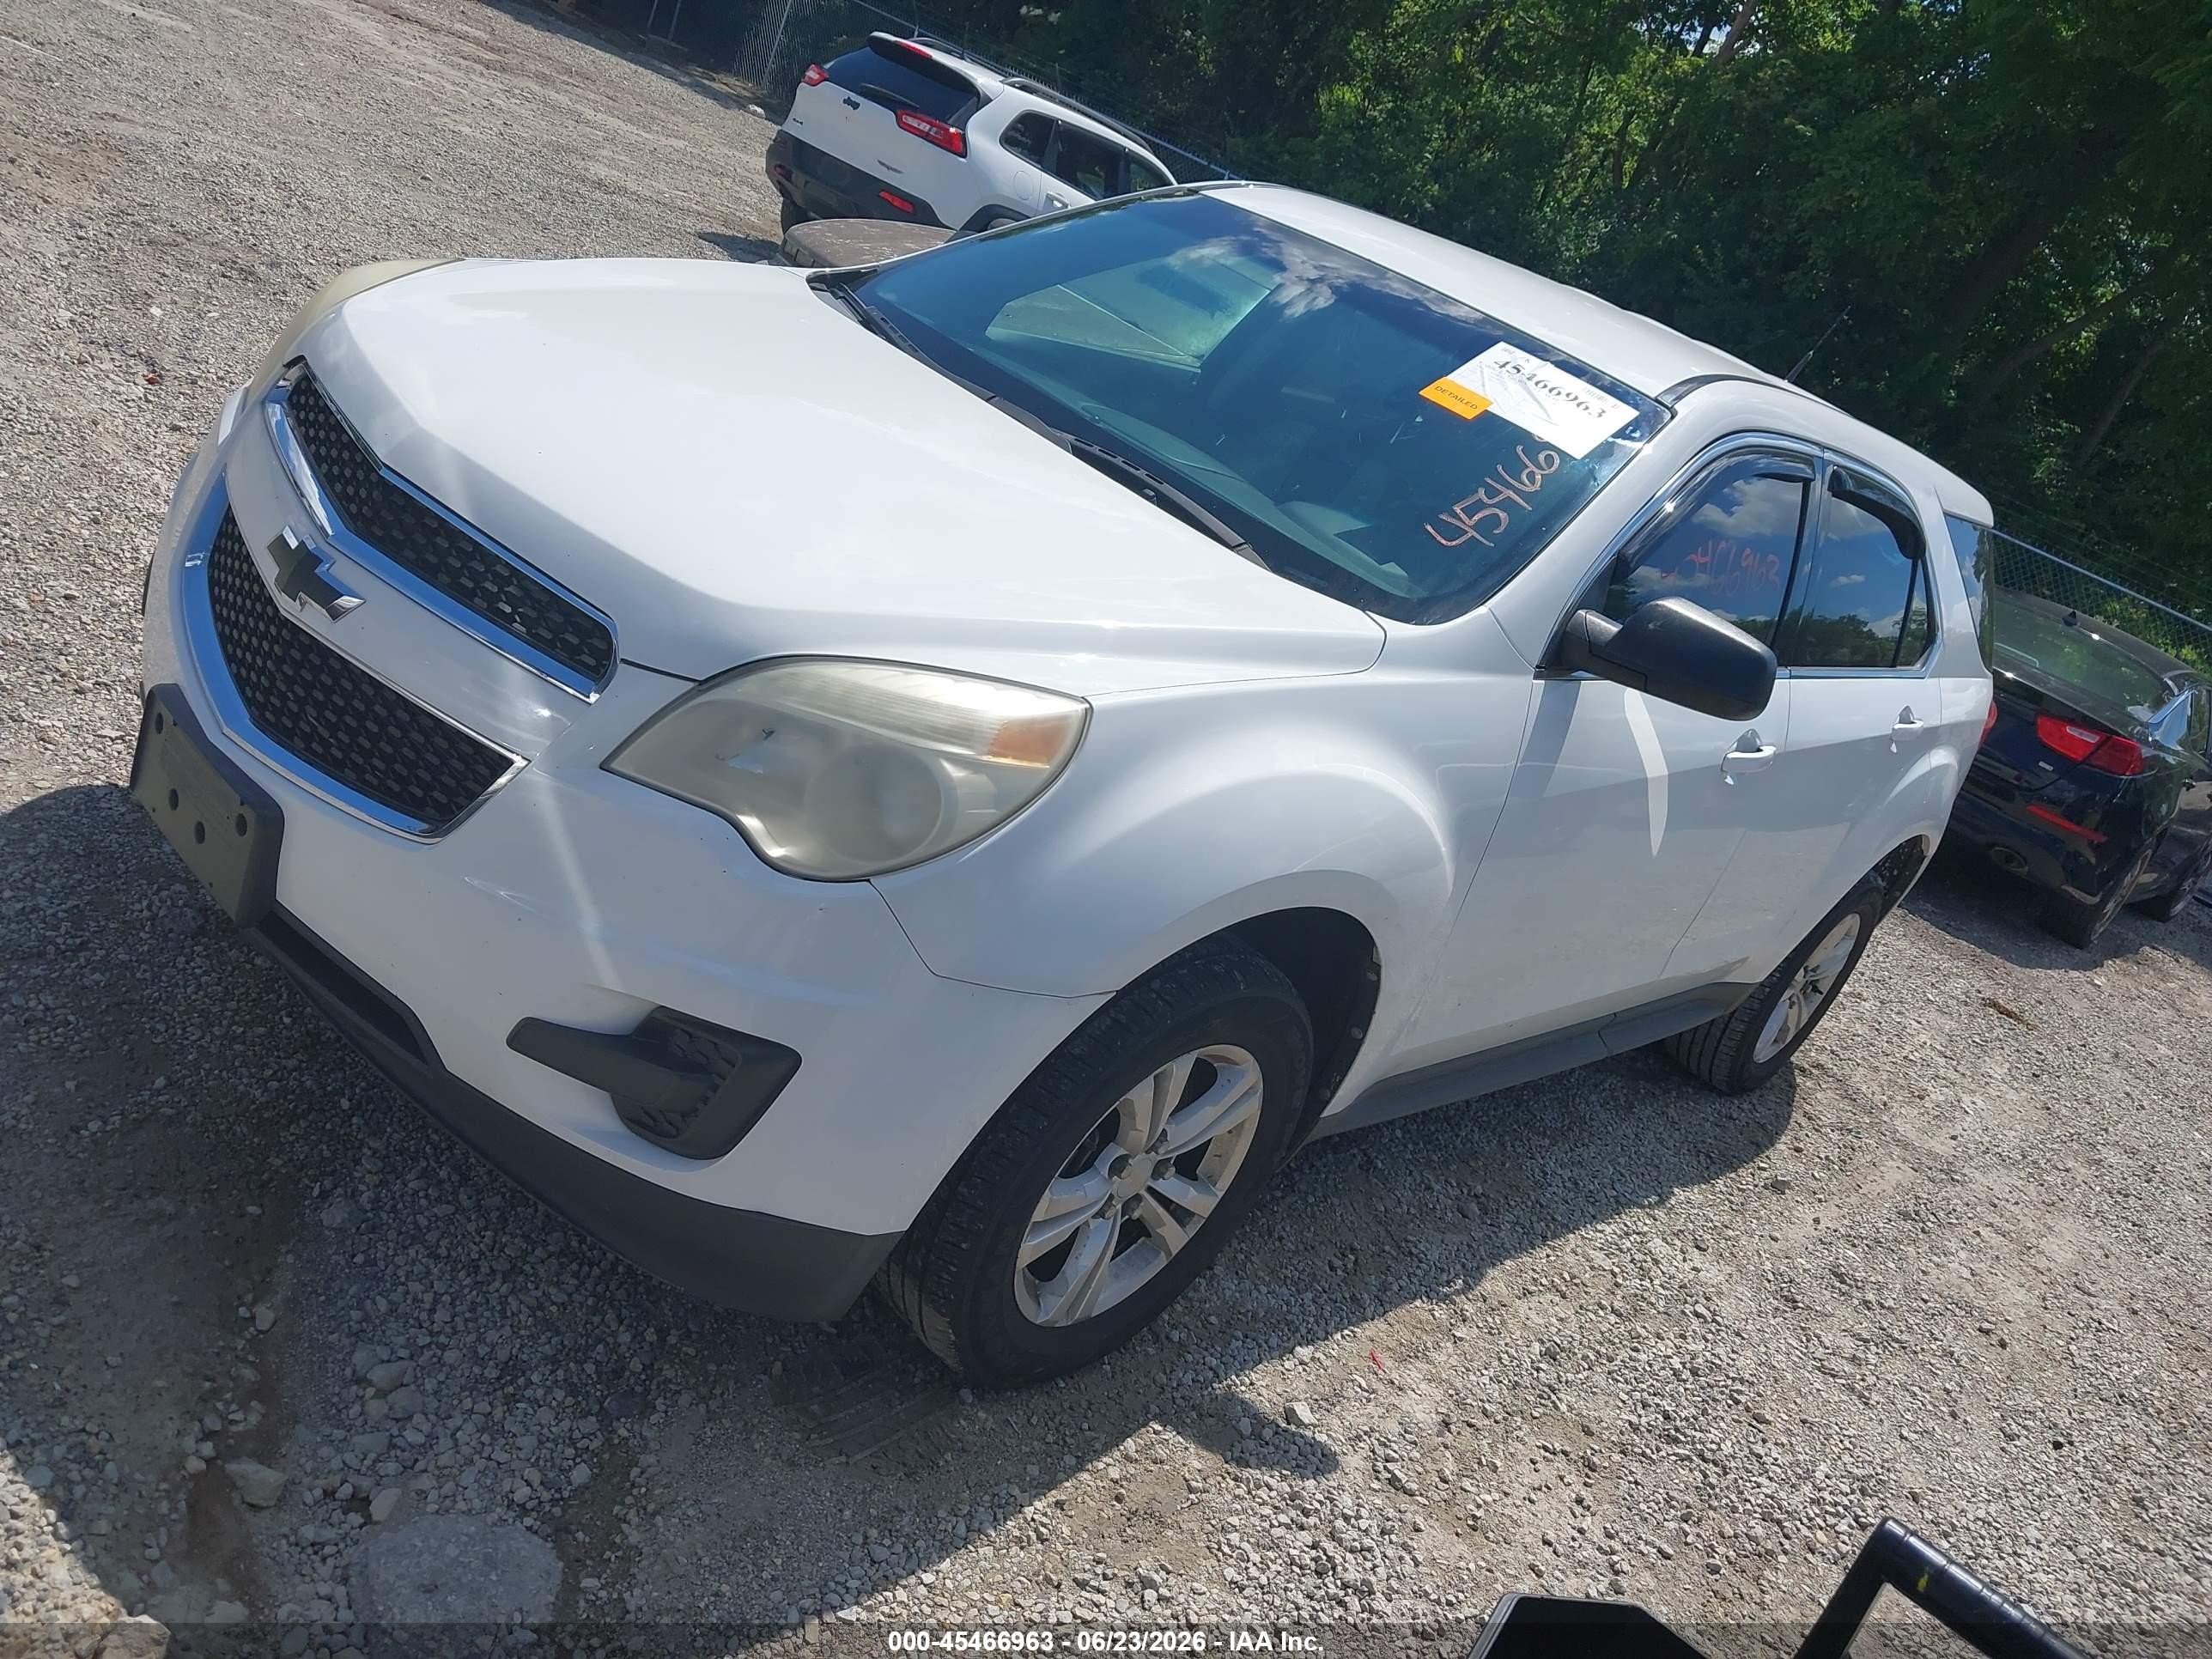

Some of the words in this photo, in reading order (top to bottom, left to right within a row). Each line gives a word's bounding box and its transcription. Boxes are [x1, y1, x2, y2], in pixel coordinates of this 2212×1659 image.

[1433, 386, 1478, 410] DETAILED
[1493, 359, 1607, 419] 45466963
[1424, 432, 1560, 548] 45466
